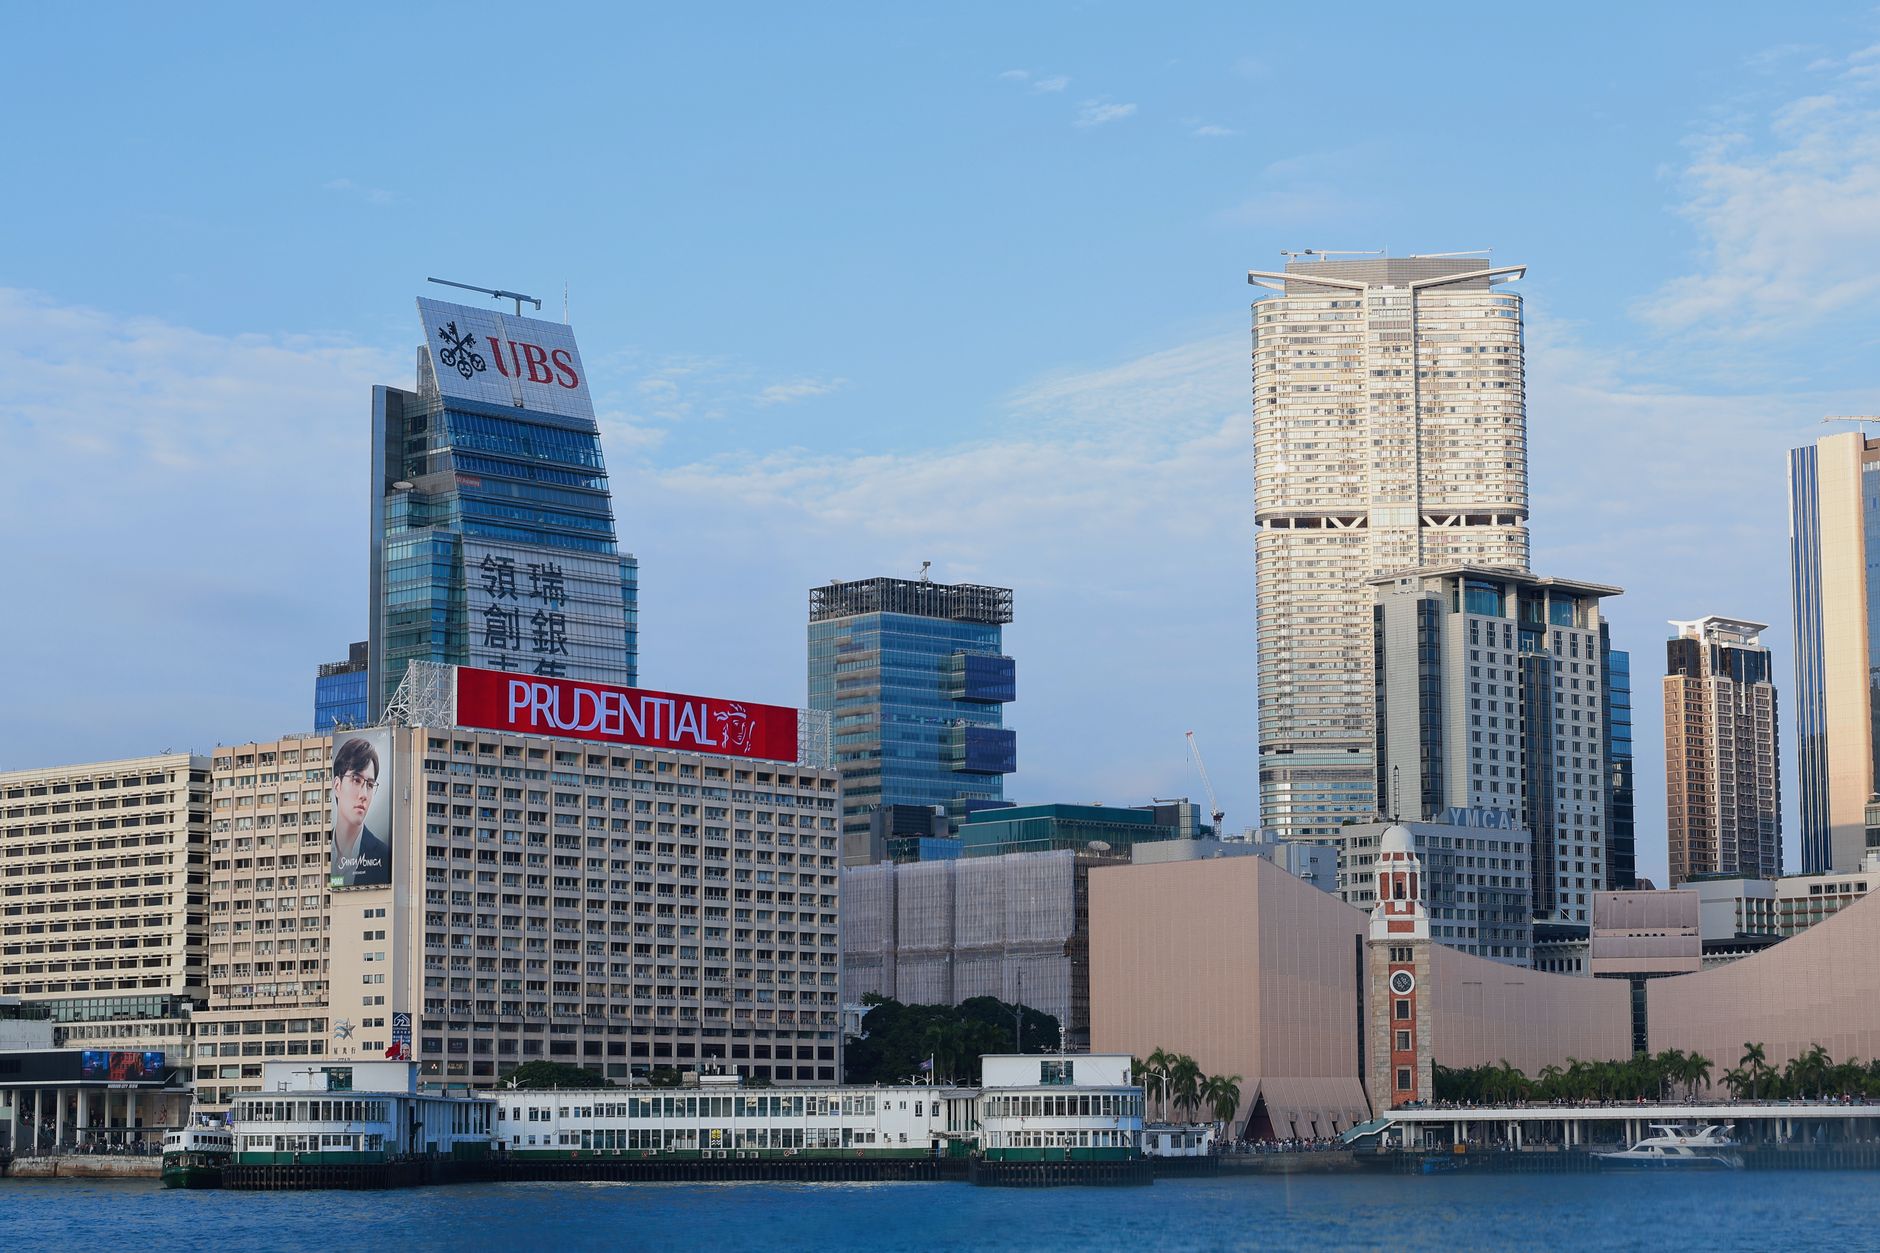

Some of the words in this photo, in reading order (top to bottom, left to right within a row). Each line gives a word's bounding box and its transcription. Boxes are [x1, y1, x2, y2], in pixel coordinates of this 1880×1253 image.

[486, 336, 579, 389] UBS
[509, 680, 717, 746] PRUDENTIAL
[1450, 807, 1511, 831] YMCA
